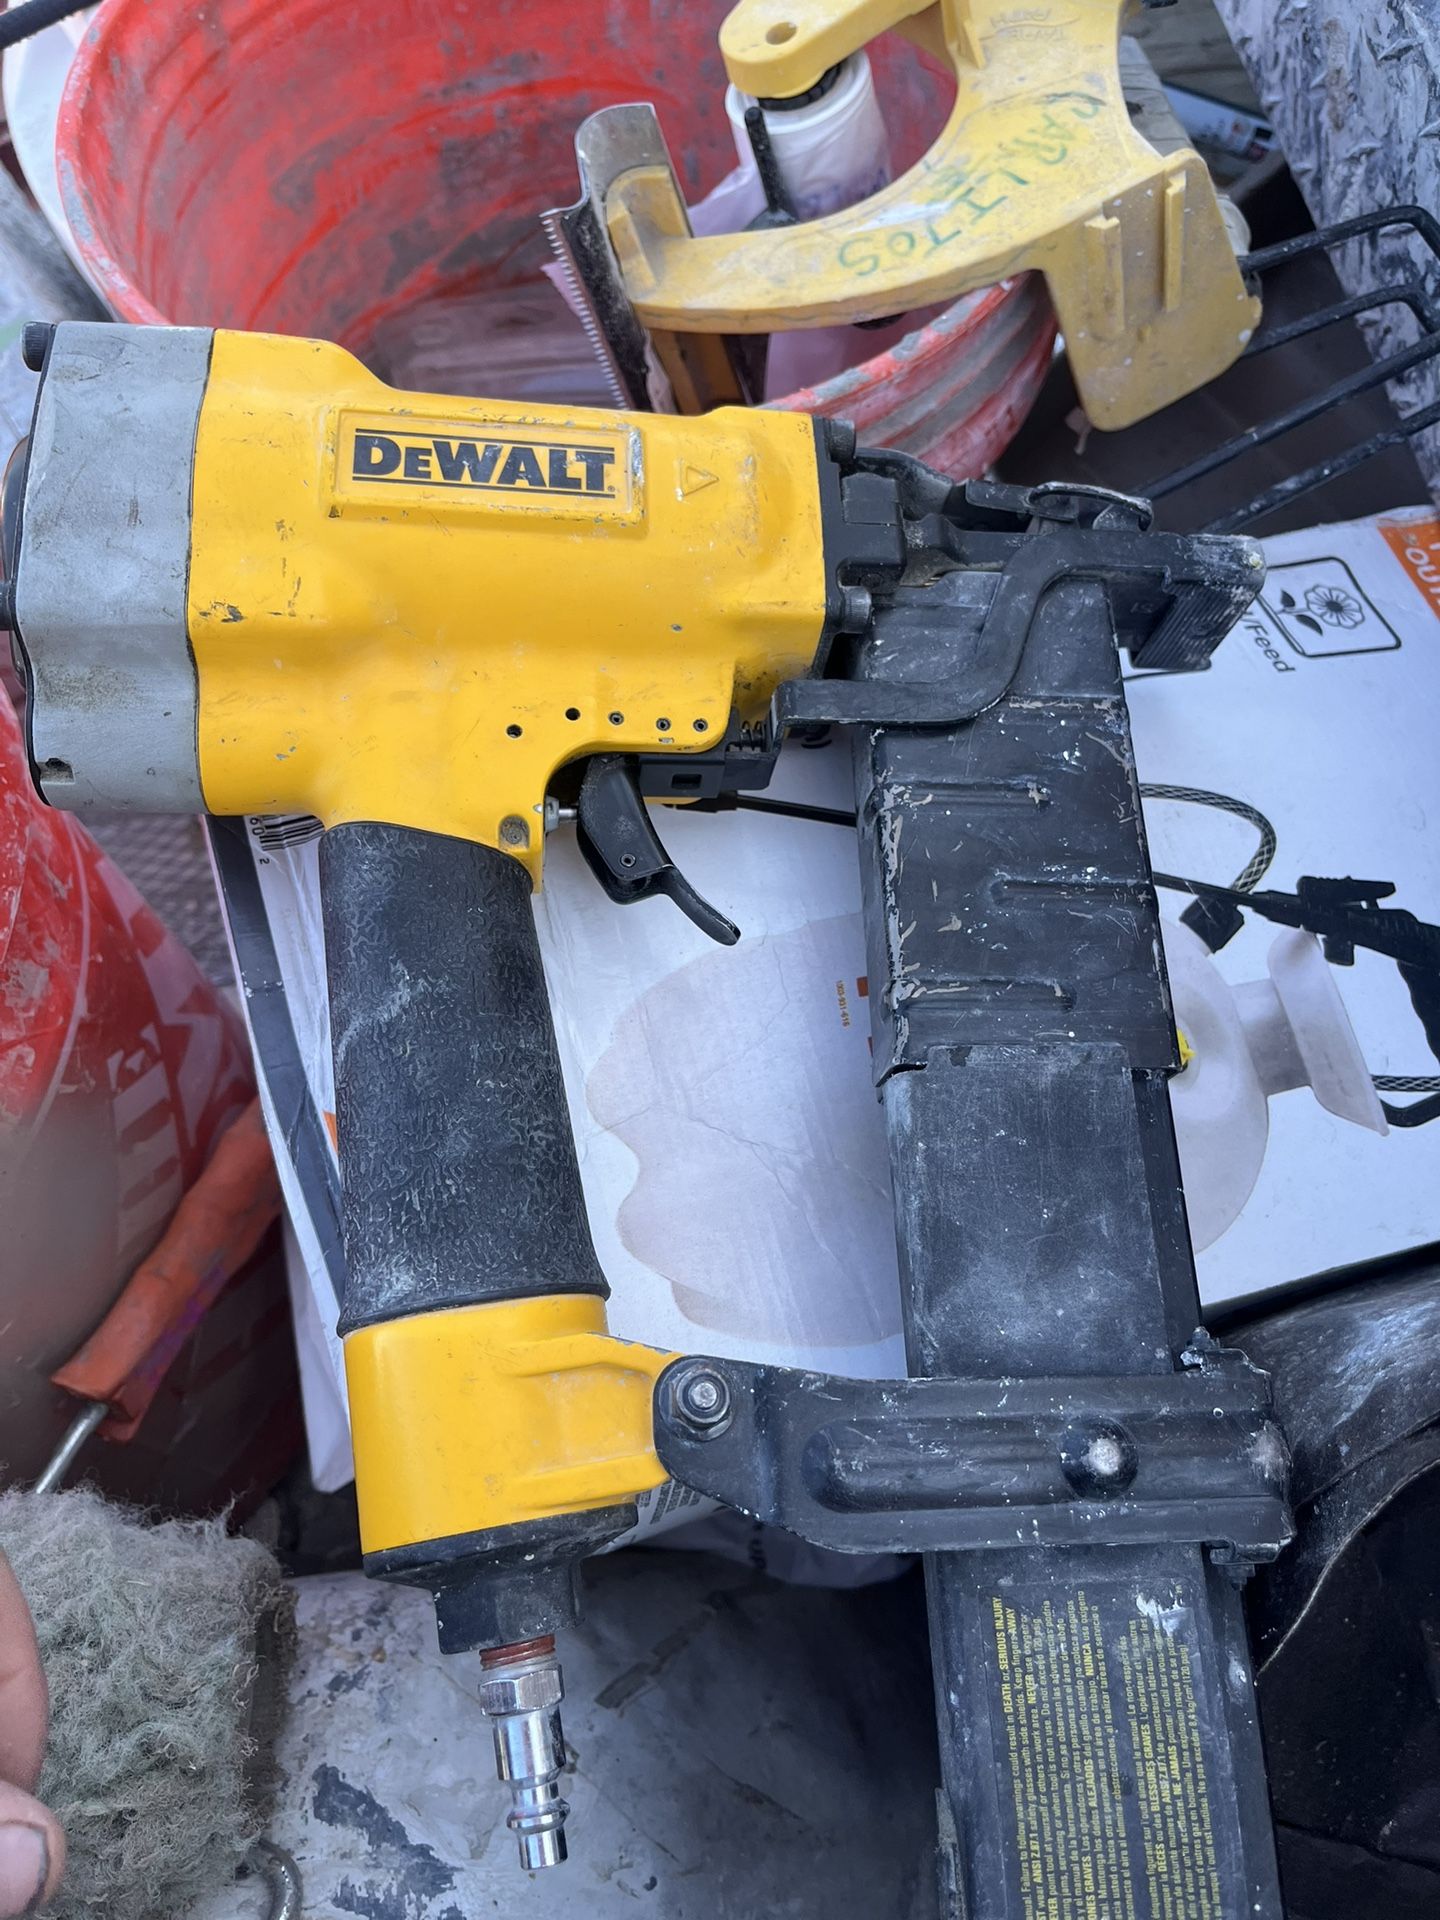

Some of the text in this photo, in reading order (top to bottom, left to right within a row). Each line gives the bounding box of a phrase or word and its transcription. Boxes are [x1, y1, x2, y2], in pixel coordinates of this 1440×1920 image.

[1005, 1607, 1016, 1634] AWAY
[1090, 1612, 1102, 1646] servicio
[1138, 1618, 1147, 1630] les
[1081, 1626, 1090, 1640] use
[997, 1631, 1009, 1669] SERIOUS
[1008, 1635, 1022, 1665] fingers
[1033, 1637, 1043, 1651] 120
[1117, 1635, 1127, 1649] des
[1059, 1650, 1068, 1660] de
[1081, 1643, 1094, 1675] NUNCA
[1094, 1648, 1104, 1659] de
[1169, 1657, 1177, 1667] se
[1025, 1657, 1033, 1671] use
[1012, 1667, 1024, 1688] Keep
[1096, 1661, 1108, 1688] tareas
[1159, 1673, 1167, 1686] sur
[1168, 1669, 1178, 1679] de
[1180, 1665, 1193, 1682] (120
[1025, 1674, 1036, 1703] NEVER
[1038, 1687, 1048, 1700] not
[1050, 1686, 1060, 1699] las
[1170, 1681, 1185, 1707] risque
[1002, 1683, 1013, 1712] DEATH
[1065, 1695, 1073, 1705] en
[1014, 1691, 1026, 1724] shields.
[1040, 1703, 1050, 1714] Do
[1100, 1691, 1112, 1722] realizar
[1125, 1704, 1135, 1714] Le
[1030, 1706, 1039, 1727] area.
[1052, 1701, 1065, 1741] observan
[1090, 1713, 1100, 1723] de
[1147, 1692, 1165, 1740] protecteurs
[1018, 1726, 1028, 1744] side
[1067, 1708, 1080, 1748] personas
[1104, 1725, 1113, 1733] al
[1162, 1714, 1177, 1743] pointer
[1174, 1709, 1191, 1749] explosion
[1006, 1725, 1016, 1749] result
[1031, 1730, 1041, 1751] work
[1044, 1737, 1053, 1745] in
[1045, 1747, 1055, 1761] not
[1059, 1744, 1067, 1754] se
[1067, 1600, 1109, 1898] Mantenga los dedos ALEJADOS del gatillo cuando no coloca seguros
[1094, 1748, 1103, 1756] el
[1154, 1742, 1164, 1752] de
[1008, 1752, 1019, 1775] could
[1020, 1747, 1030, 1765] with
[1060, 1757, 1068, 1767] no
[1070, 1750, 1081, 1773] otras
[1097, 1758, 1105, 1769] en
[1166, 1745, 1179, 1780] JAMAIS
[1180, 1751, 1190, 1767] Une
[1060, 1770, 1069, 1778] Si
[1134, 1760, 1145, 1776] que
[1195, 1763, 1207, 1778] pas
[1022, 1767, 1036, 1800] glasses
[1034, 1764, 1045, 1791] others
[1048, 1773, 1058, 1789] tool
[1144, 1761, 1159, 1811] BLESSURES
[1098, 1772, 1112, 1812] personas
[1135, 1779, 1145, 1798] ainsi
[1171, 1782, 1181, 1794] NE
[1196, 1781, 1206, 1792] Ne
[1011, 1778, 1026, 1819] warnings
[1039, 1794, 1046, 1803] or
[1049, 1792, 1060, 1816] when
[1073, 1782, 1090, 1833] operadores
[1162, 1805, 1172, 1815] de
[1189, 1809, 1197, 1820] en
[1026, 1804, 1039, 1829] safety
[1038, 1806, 1053, 1841] yourself
[1054, 1819, 1062, 1828] or
[1113, 1801, 1125, 1837] eliminar
[1151, 1813, 1161, 1828] des
[1101, 1814, 1113, 1837] otras
[1142, 1826, 1150, 1839] sur
[1190, 1822, 1201, 1836] gaz
[1015, 1821, 1026, 1848] follow
[1079, 1835, 1089, 1850] Los
[1117, 1839, 1126, 1847] al
[1154, 1830, 1163, 1840] ou
[1202, 1832, 1212, 1844] est
[1018, 1850, 1027, 1859] to
[1042, 1843, 1051, 1851] at
[1053, 1831, 1068, 1869] servicing
[1068, 1850, 1078, 1860] de
[1104, 1839, 1116, 1863] hacia
[1043, 1854, 1053, 1871] tool
[1118, 1850, 1129, 1866] aire
[1142, 1841, 1157, 1874] figurant
[1182, 1856, 1190, 1866] un
[1019, 1862, 1030, 1891] Failure
[1031, 1860, 1042, 1882] ANSI
[1070, 1863, 1082, 1895] manual
[1158, 1873, 1167, 1881] le
[1045, 1873, 1058, 1894] point
[1058, 1872, 1071, 1895] jams,
[1108, 1874, 1119, 1898] usted
[1197, 1875, 1205, 1886] ou
[1207, 1872, 1222, 1903] lorsque
[1035, 1885, 1044, 1907] wear
[1171, 1886, 1181, 1896] de
